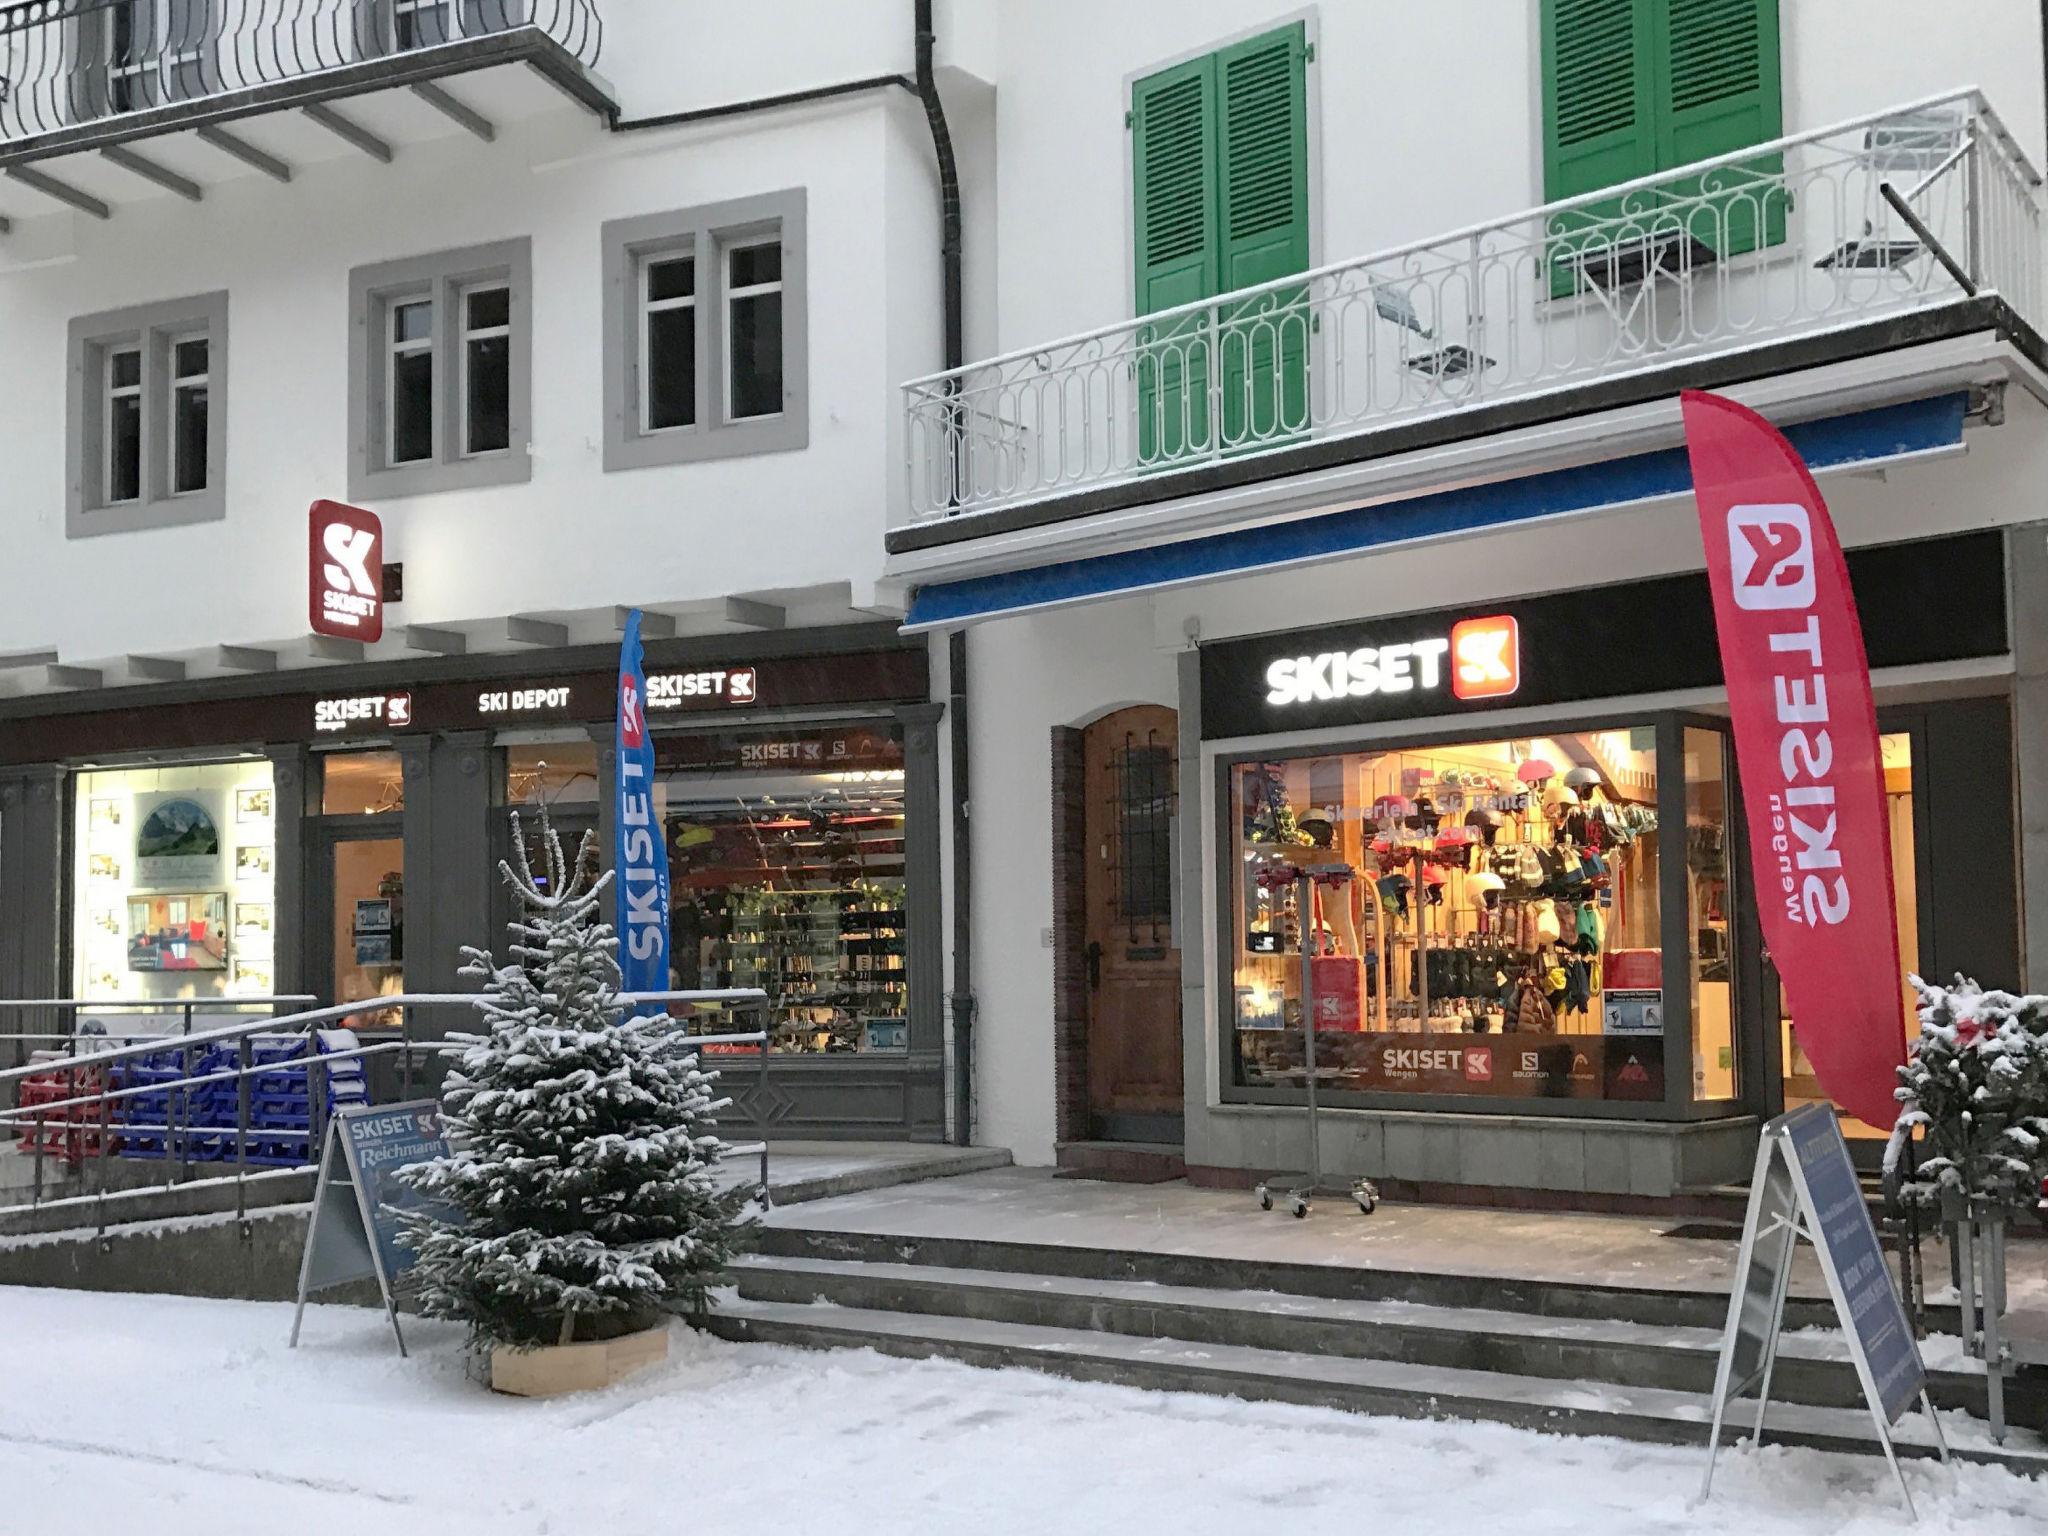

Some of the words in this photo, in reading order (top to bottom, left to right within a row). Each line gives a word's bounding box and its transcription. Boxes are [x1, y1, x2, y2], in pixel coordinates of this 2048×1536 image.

[1266, 638, 1449, 705] SKISET
[646, 672, 726, 698] SKISET
[315, 697, 386, 722] SKISET
[479, 692, 508, 712] SKI
[512, 688, 570, 710] DEPOT
[741, 742, 800, 761] SKISET
[622, 751, 664, 960] SKISET
[1383, 1049, 1462, 1070] SKISET
[1384, 1069, 1418, 1079] Wengen
[352, 1114, 413, 1140] SKISET
[360, 1140, 442, 1169] Reichmann
